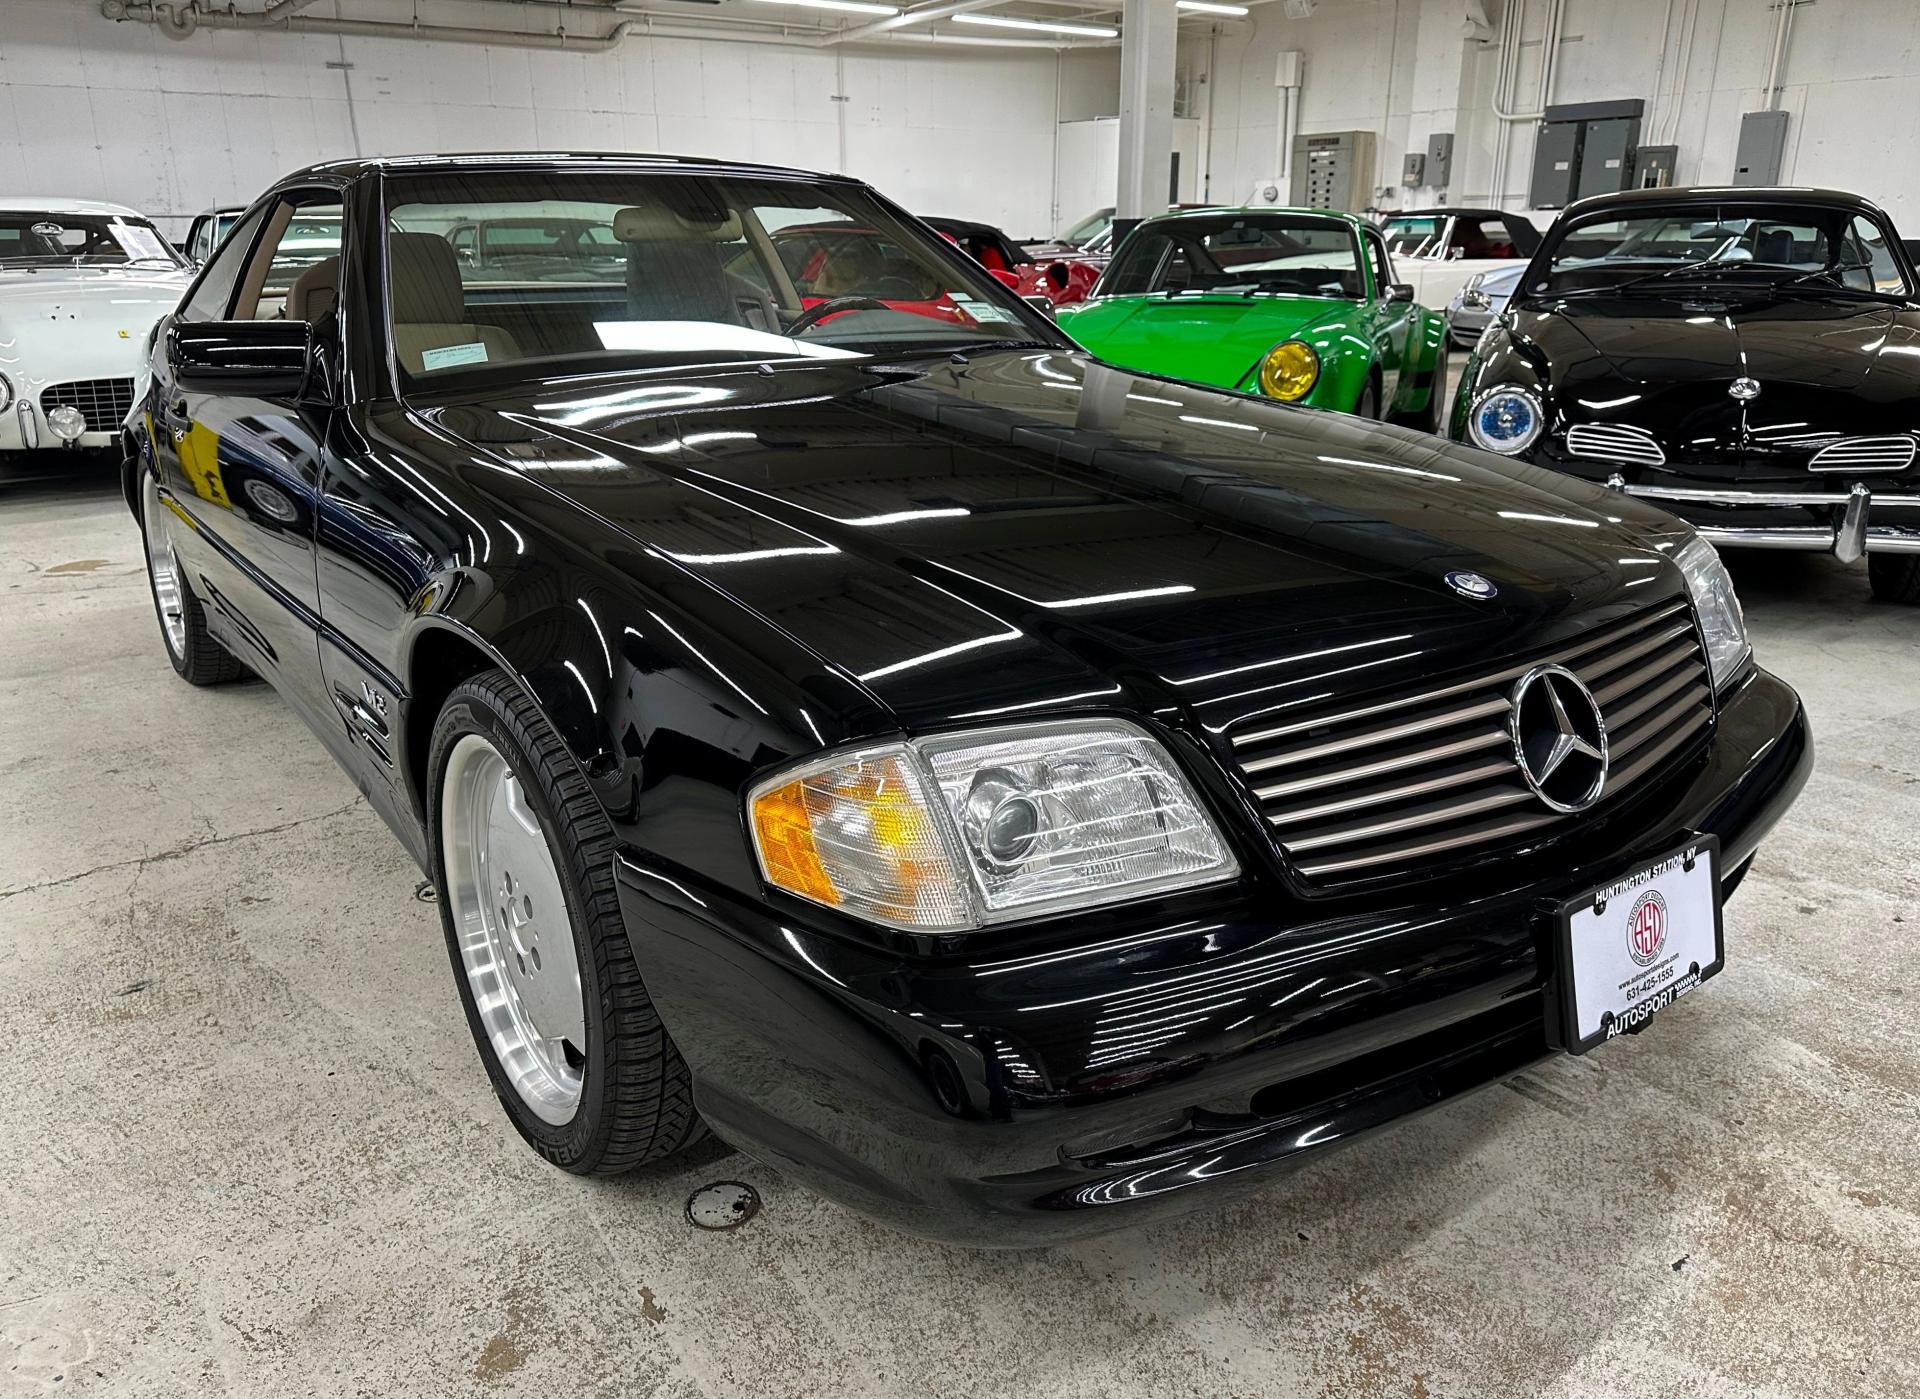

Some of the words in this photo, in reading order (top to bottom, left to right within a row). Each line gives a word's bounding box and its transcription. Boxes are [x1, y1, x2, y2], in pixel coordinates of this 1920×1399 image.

[361, 680, 387, 716] V12
[1595, 868, 1651, 905] HUNTINGTON
[1652, 853, 1685, 878] STATION,
[1686, 846, 1697, 862] NY
[1618, 952, 1680, 991] www.autosportdesigns.com
[1626, 965, 1674, 1001] 631-425-1555
[1606, 986, 1674, 1040] AUTOSPORT
